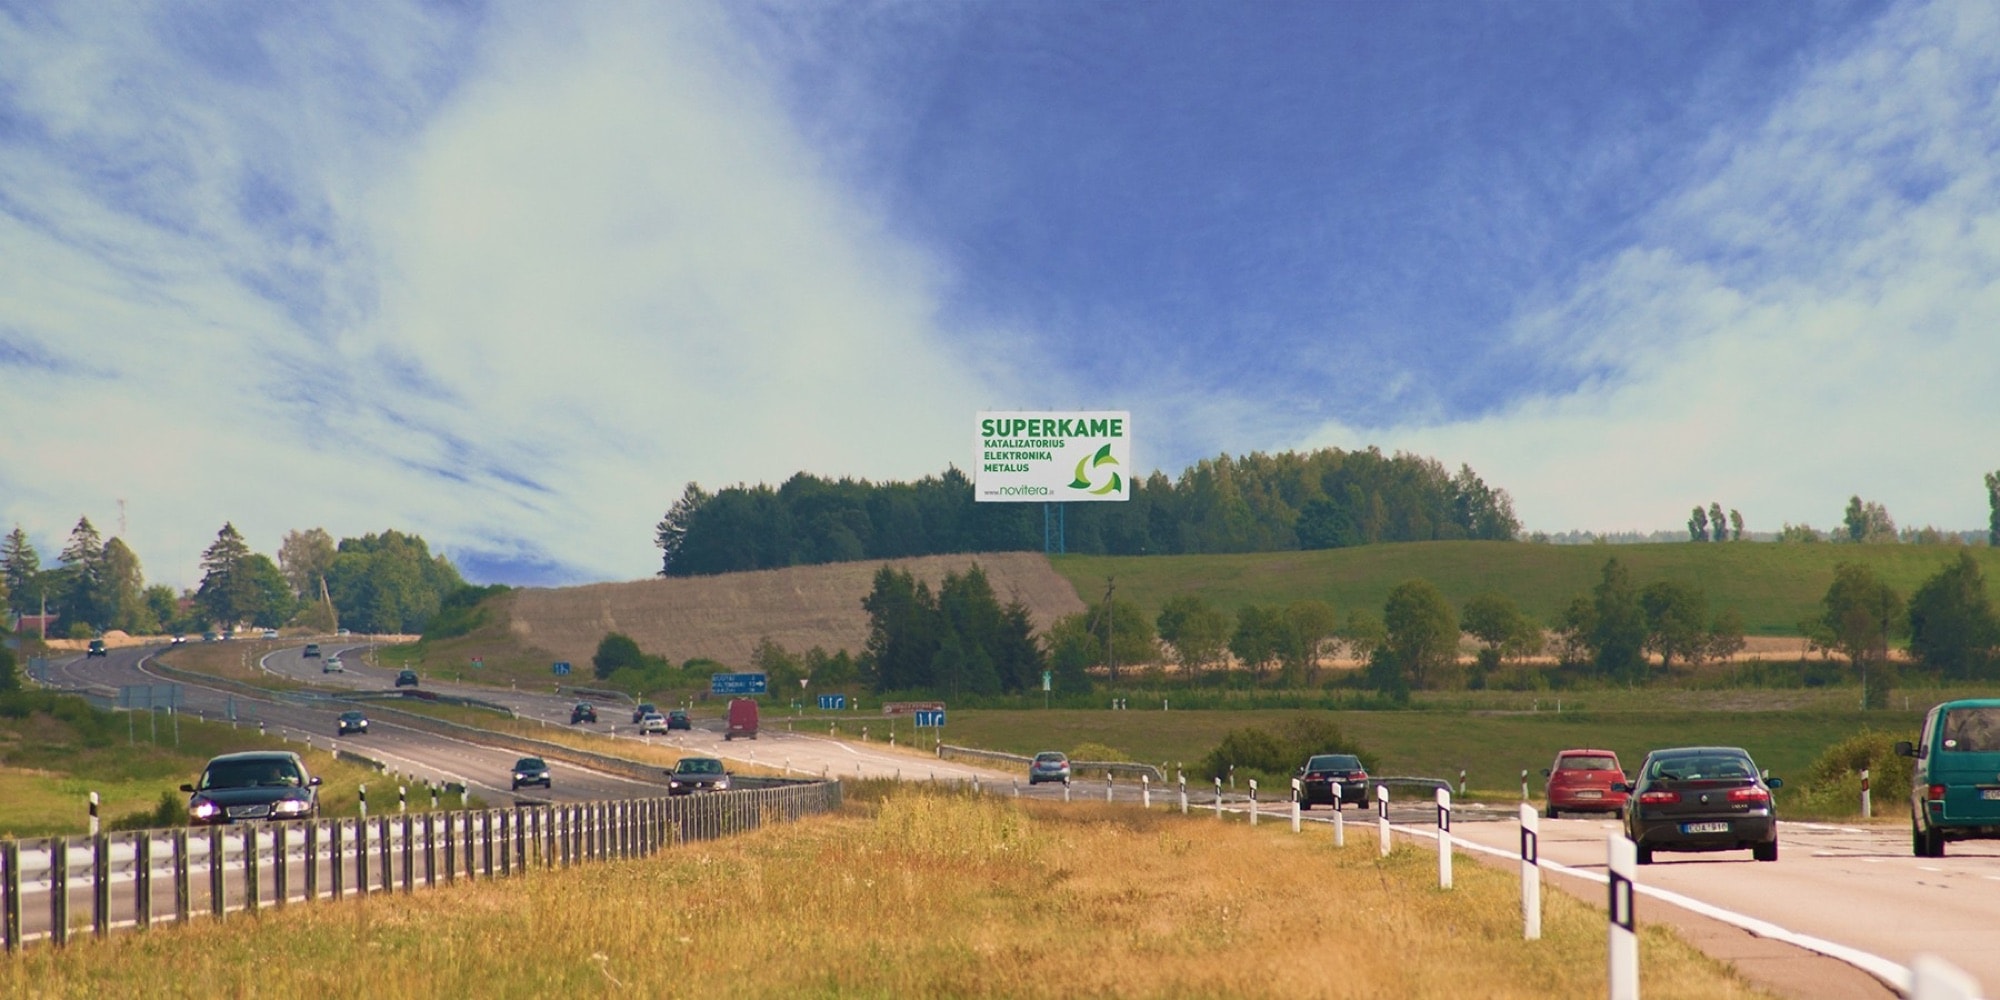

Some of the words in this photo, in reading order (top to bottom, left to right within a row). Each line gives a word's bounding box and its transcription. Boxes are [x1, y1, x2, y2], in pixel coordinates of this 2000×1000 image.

[981, 418, 1123, 437] SUPERKAME
[984, 439, 1065, 448] KATALIZATORIUS
[984, 451, 1053, 462] ELEKTRONIKĄ
[984, 463, 1030, 472] METALUS
